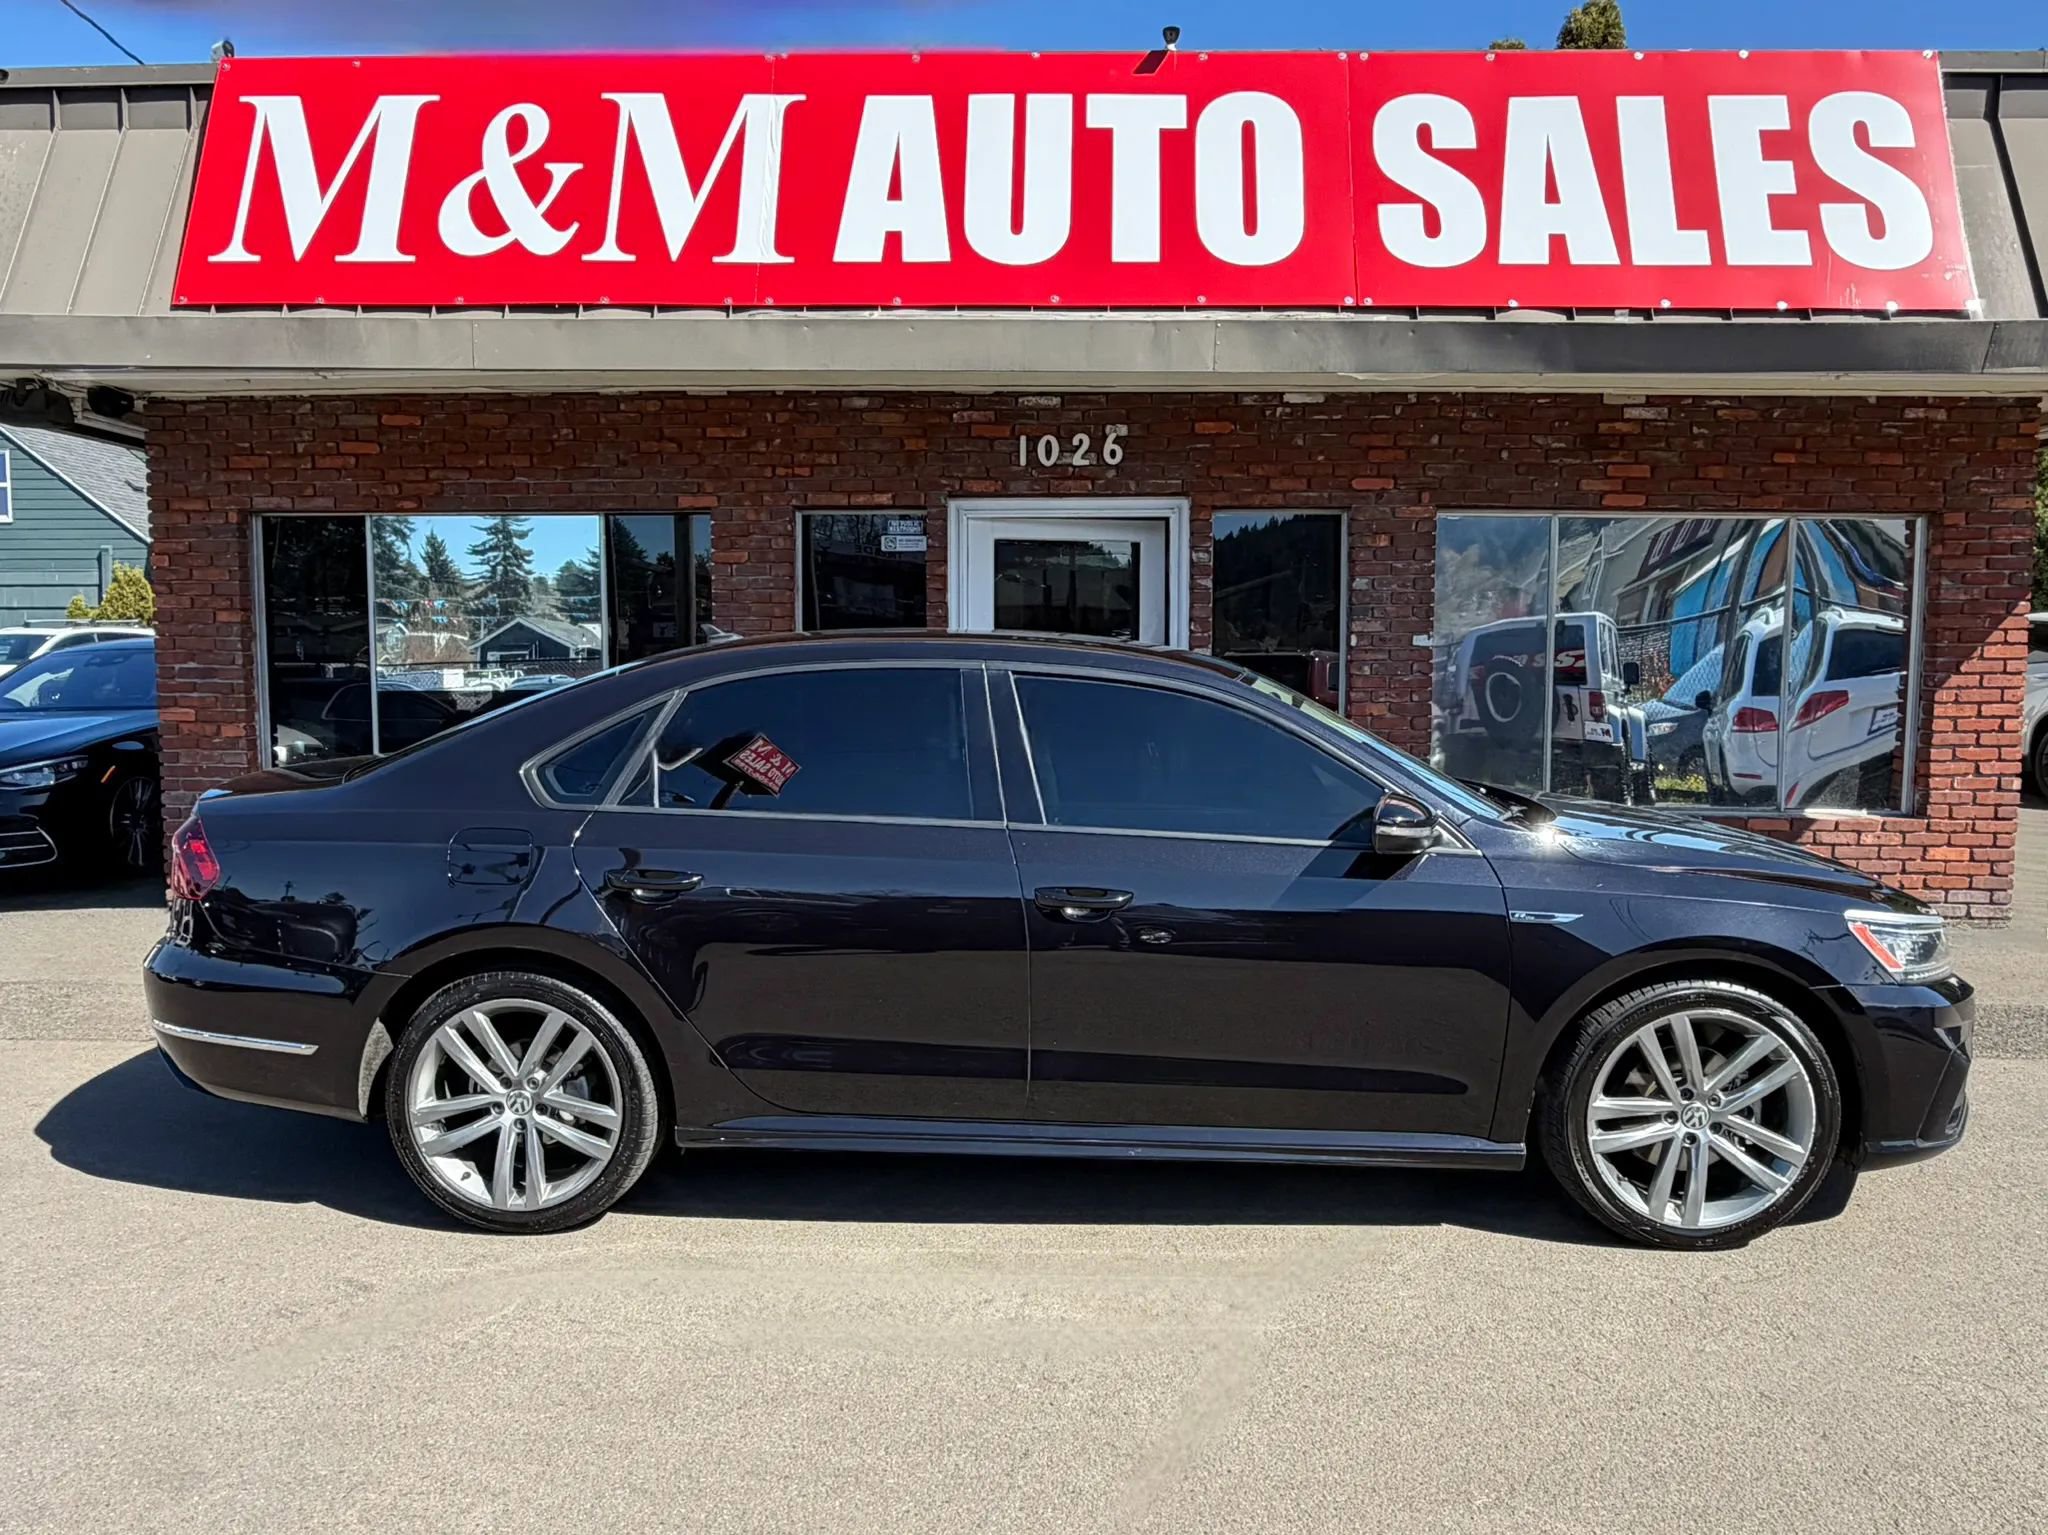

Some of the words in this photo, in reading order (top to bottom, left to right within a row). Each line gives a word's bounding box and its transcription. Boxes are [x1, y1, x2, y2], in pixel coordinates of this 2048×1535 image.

[207, 93, 806, 264] M&M
[832, 91, 1305, 266] AUTO
[1372, 91, 1934, 271] SALES
[1019, 432, 1124, 468] 1026
